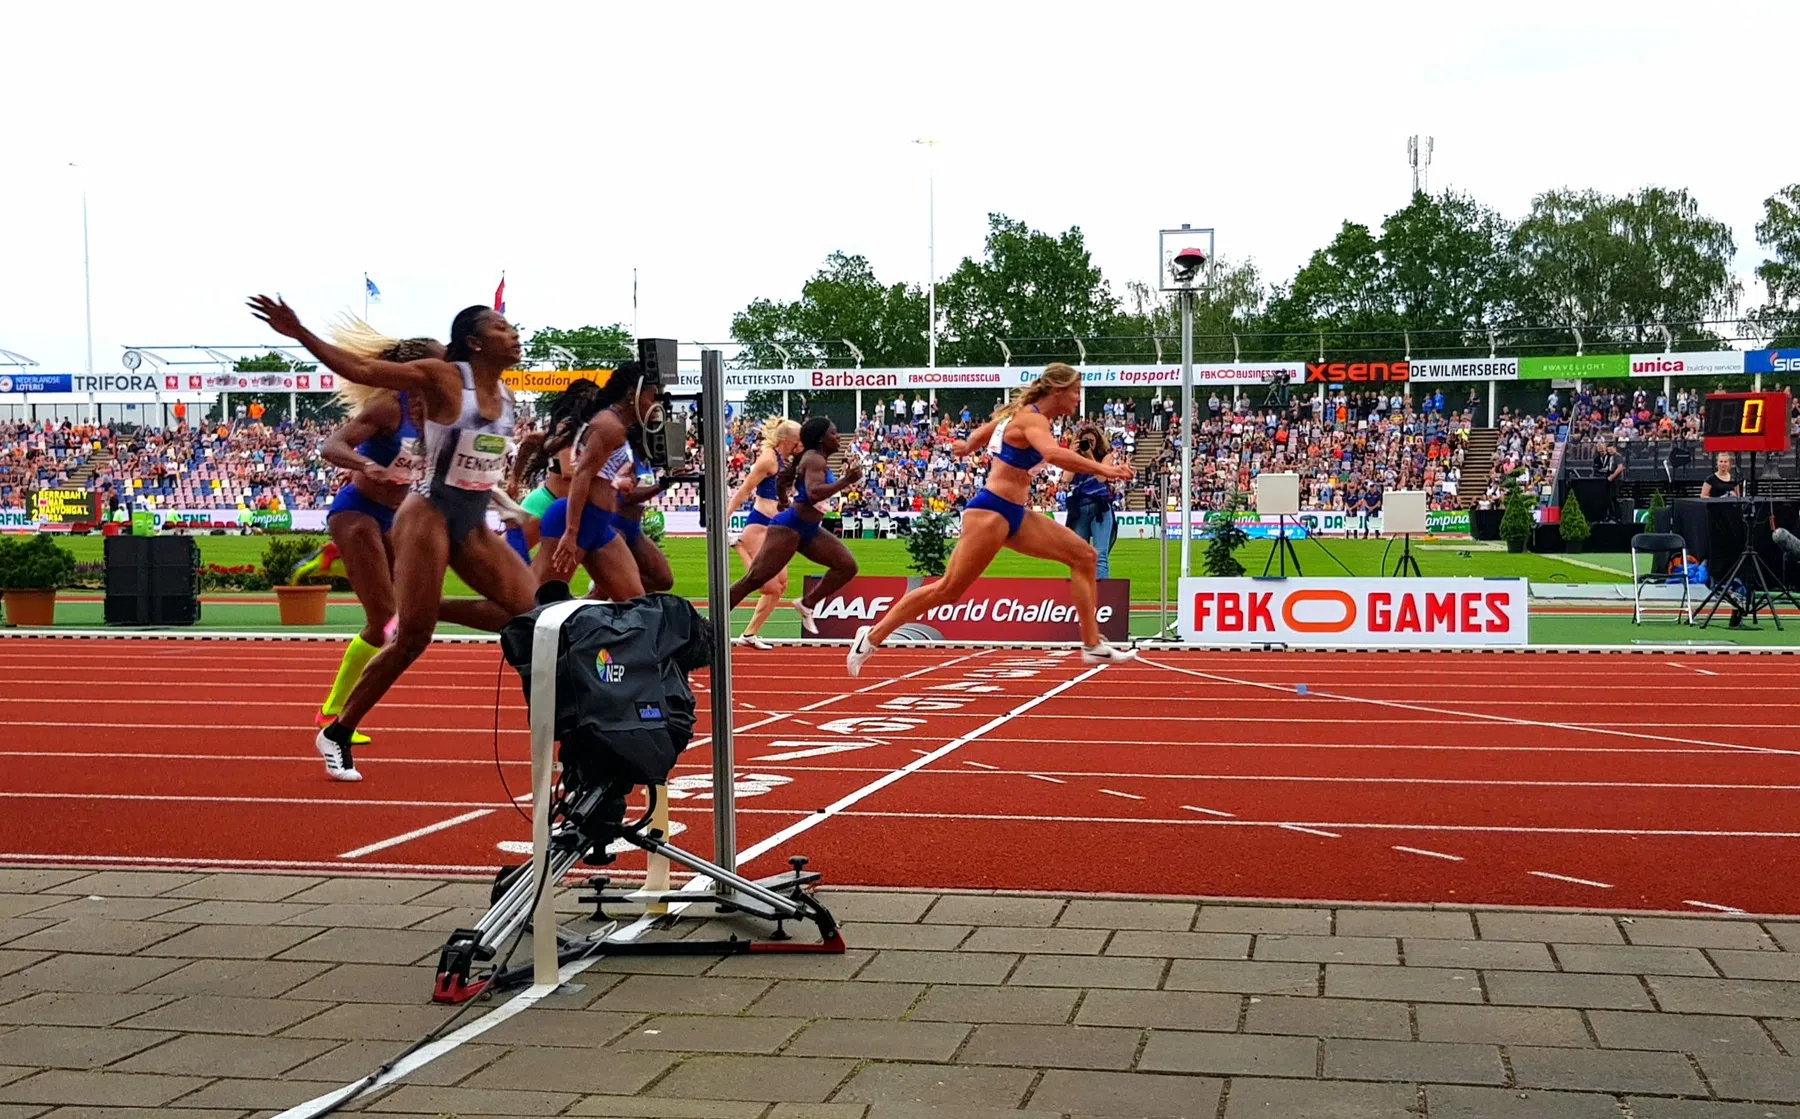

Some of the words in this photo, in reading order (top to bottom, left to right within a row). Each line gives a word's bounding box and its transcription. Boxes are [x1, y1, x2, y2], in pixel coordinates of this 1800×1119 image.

[1306, 362, 1410, 382] xsens
[1411, 365, 1426, 377] DE
[1430, 363, 1516, 376] WILMERSBERG
[1632, 357, 1684, 373] unica
[1686, 364, 1712, 373] building
[75, 376, 157, 390] TRIFORA
[524, 374, 570, 386] Stadion
[726, 375, 795, 385] ATLETIEKSTAD
[812, 371, 897, 387] Barbacan
[943, 374, 1000, 383] BUSINESSCLUB
[1105, 369, 1116, 381] is
[1119, 368, 1180, 384] topsport!
[1740, 399, 1764, 433] 0
[813, 596, 894, 619] IAAF
[991, 598, 1113, 623] Challene
[1194, 592, 1276, 632] FBK
[1368, 592, 1510, 632] GAMES
[606, 664, 625, 682] NEP
[746, 740, 879, 761] 7
